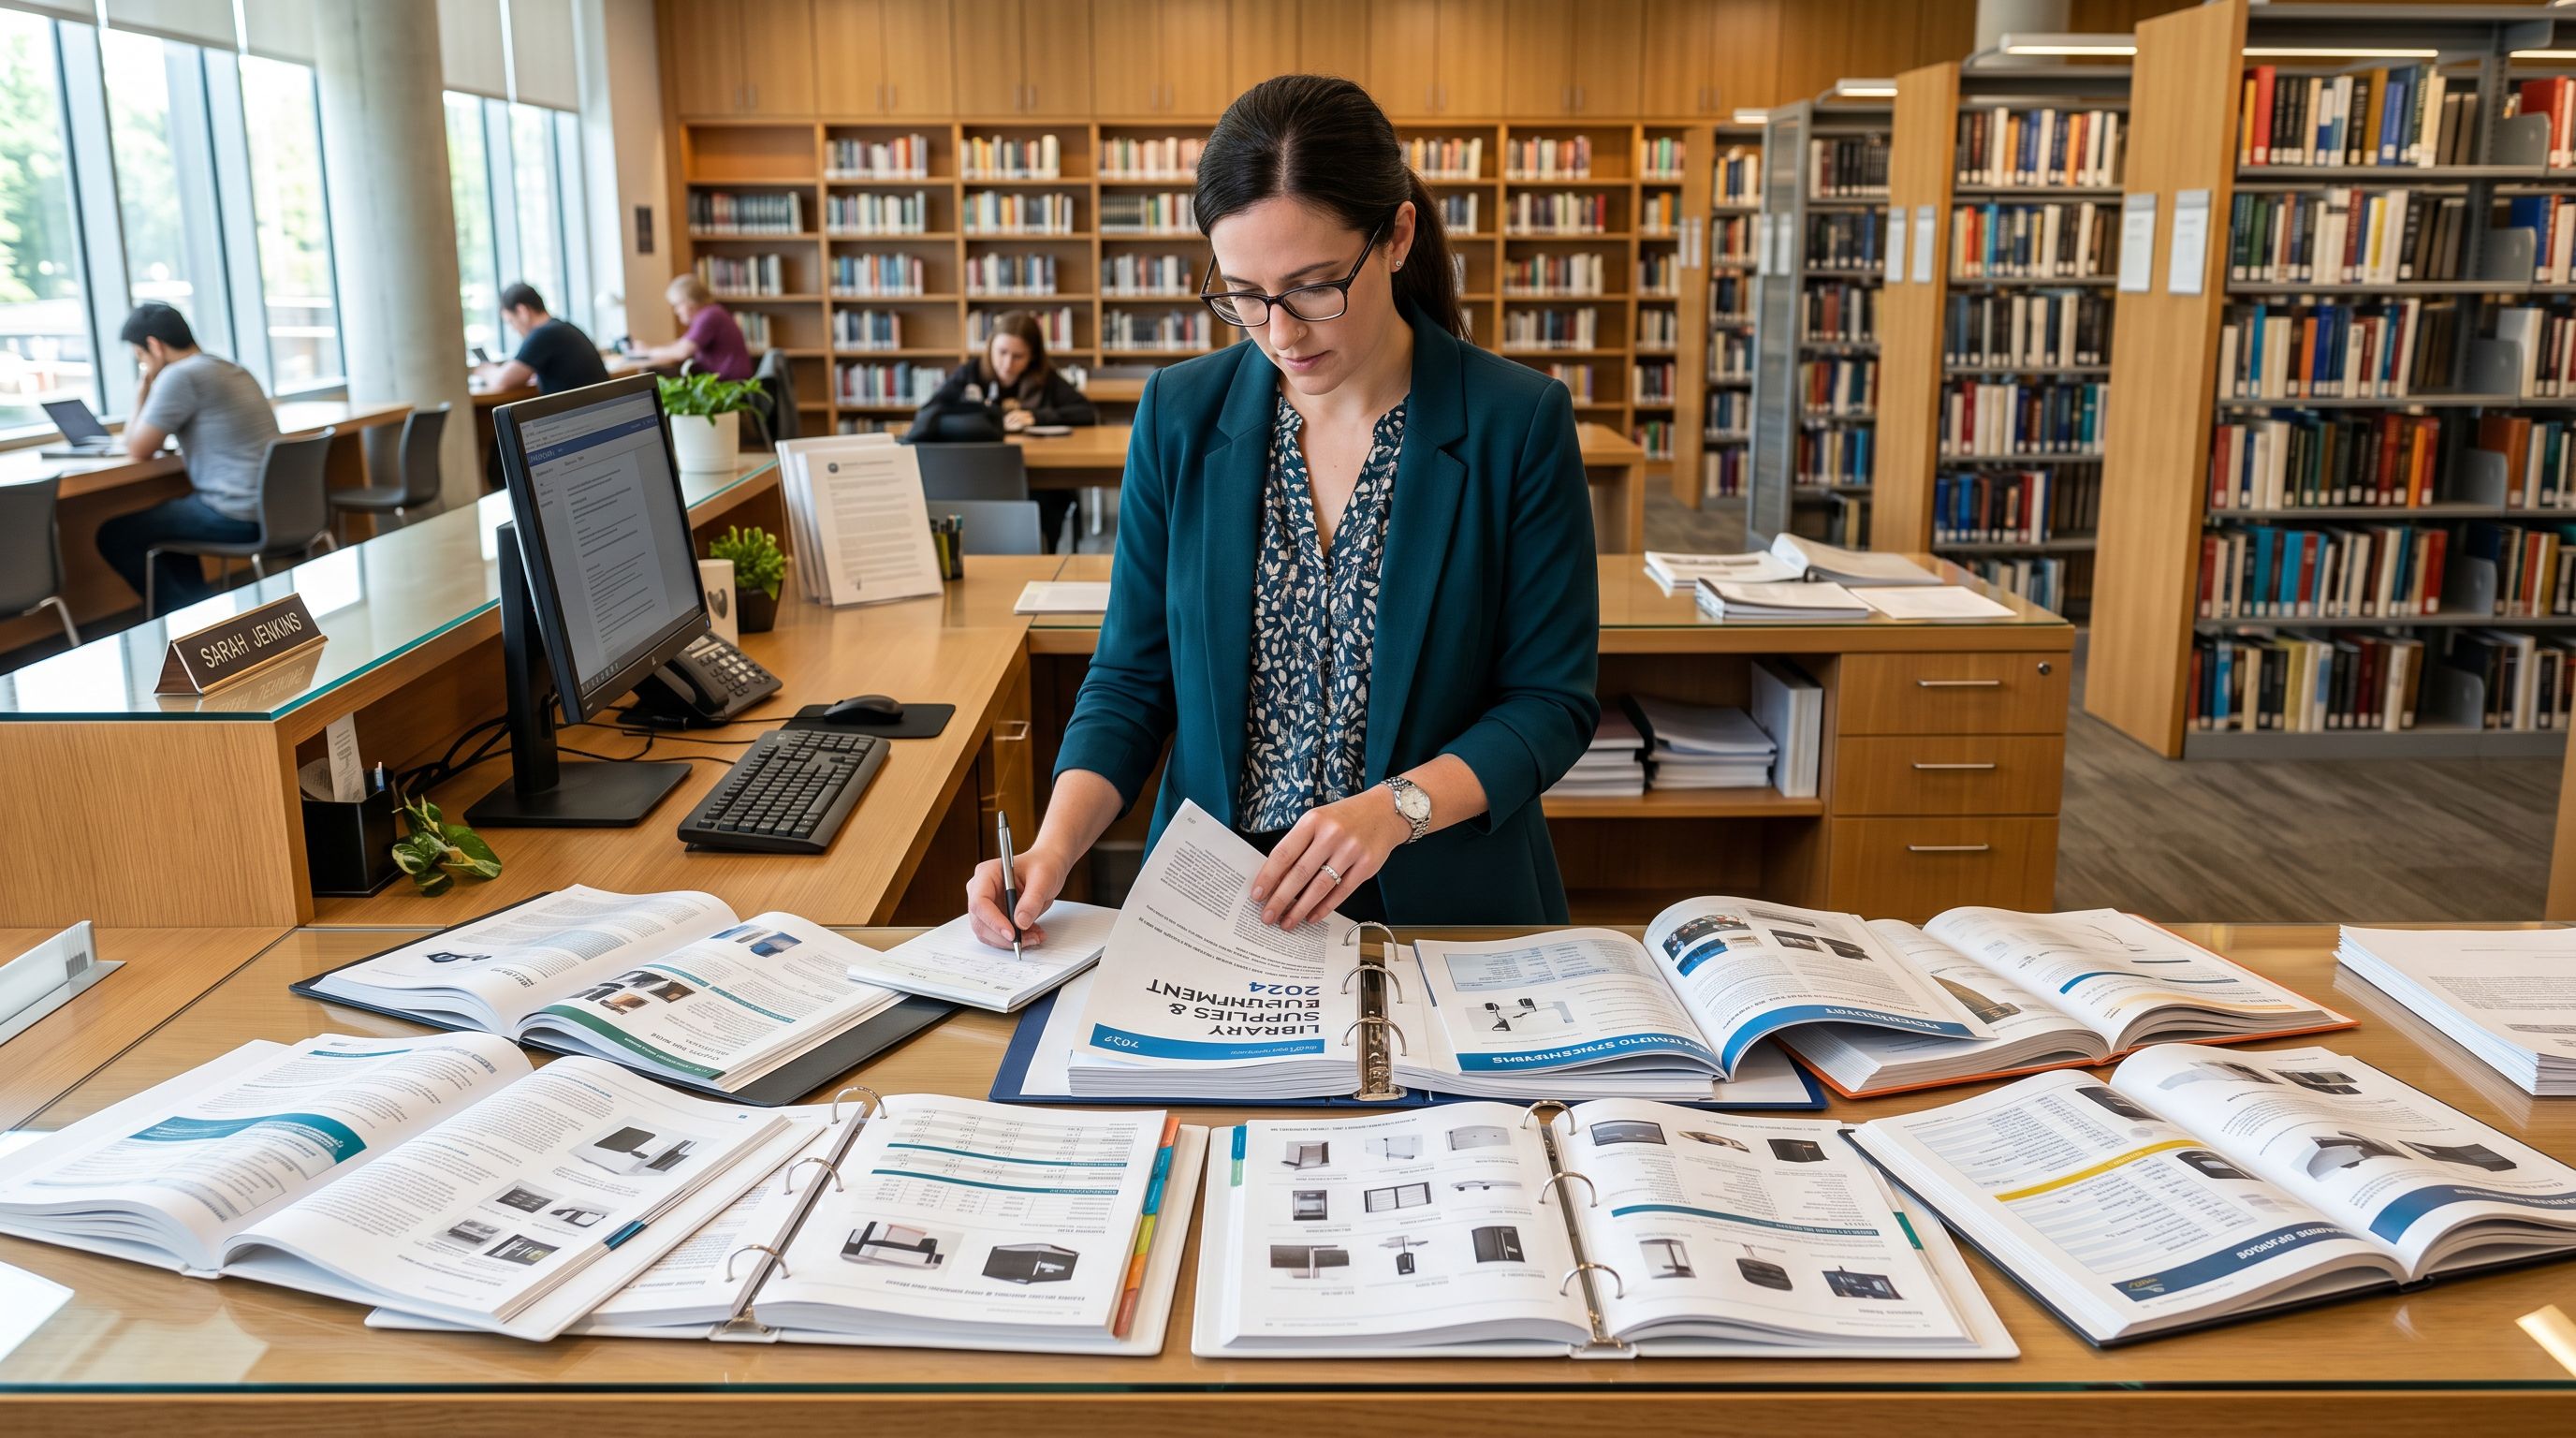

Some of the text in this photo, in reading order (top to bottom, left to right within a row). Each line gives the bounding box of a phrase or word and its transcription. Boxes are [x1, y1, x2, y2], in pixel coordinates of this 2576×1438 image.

[200, 611, 302, 668] SARAH JENKINS
[1249, 981, 1321, 996] 2024
[1168, 1003, 1321, 1022] SUPPLIES &
[1207, 1024, 1320, 1036] LIBRARY
